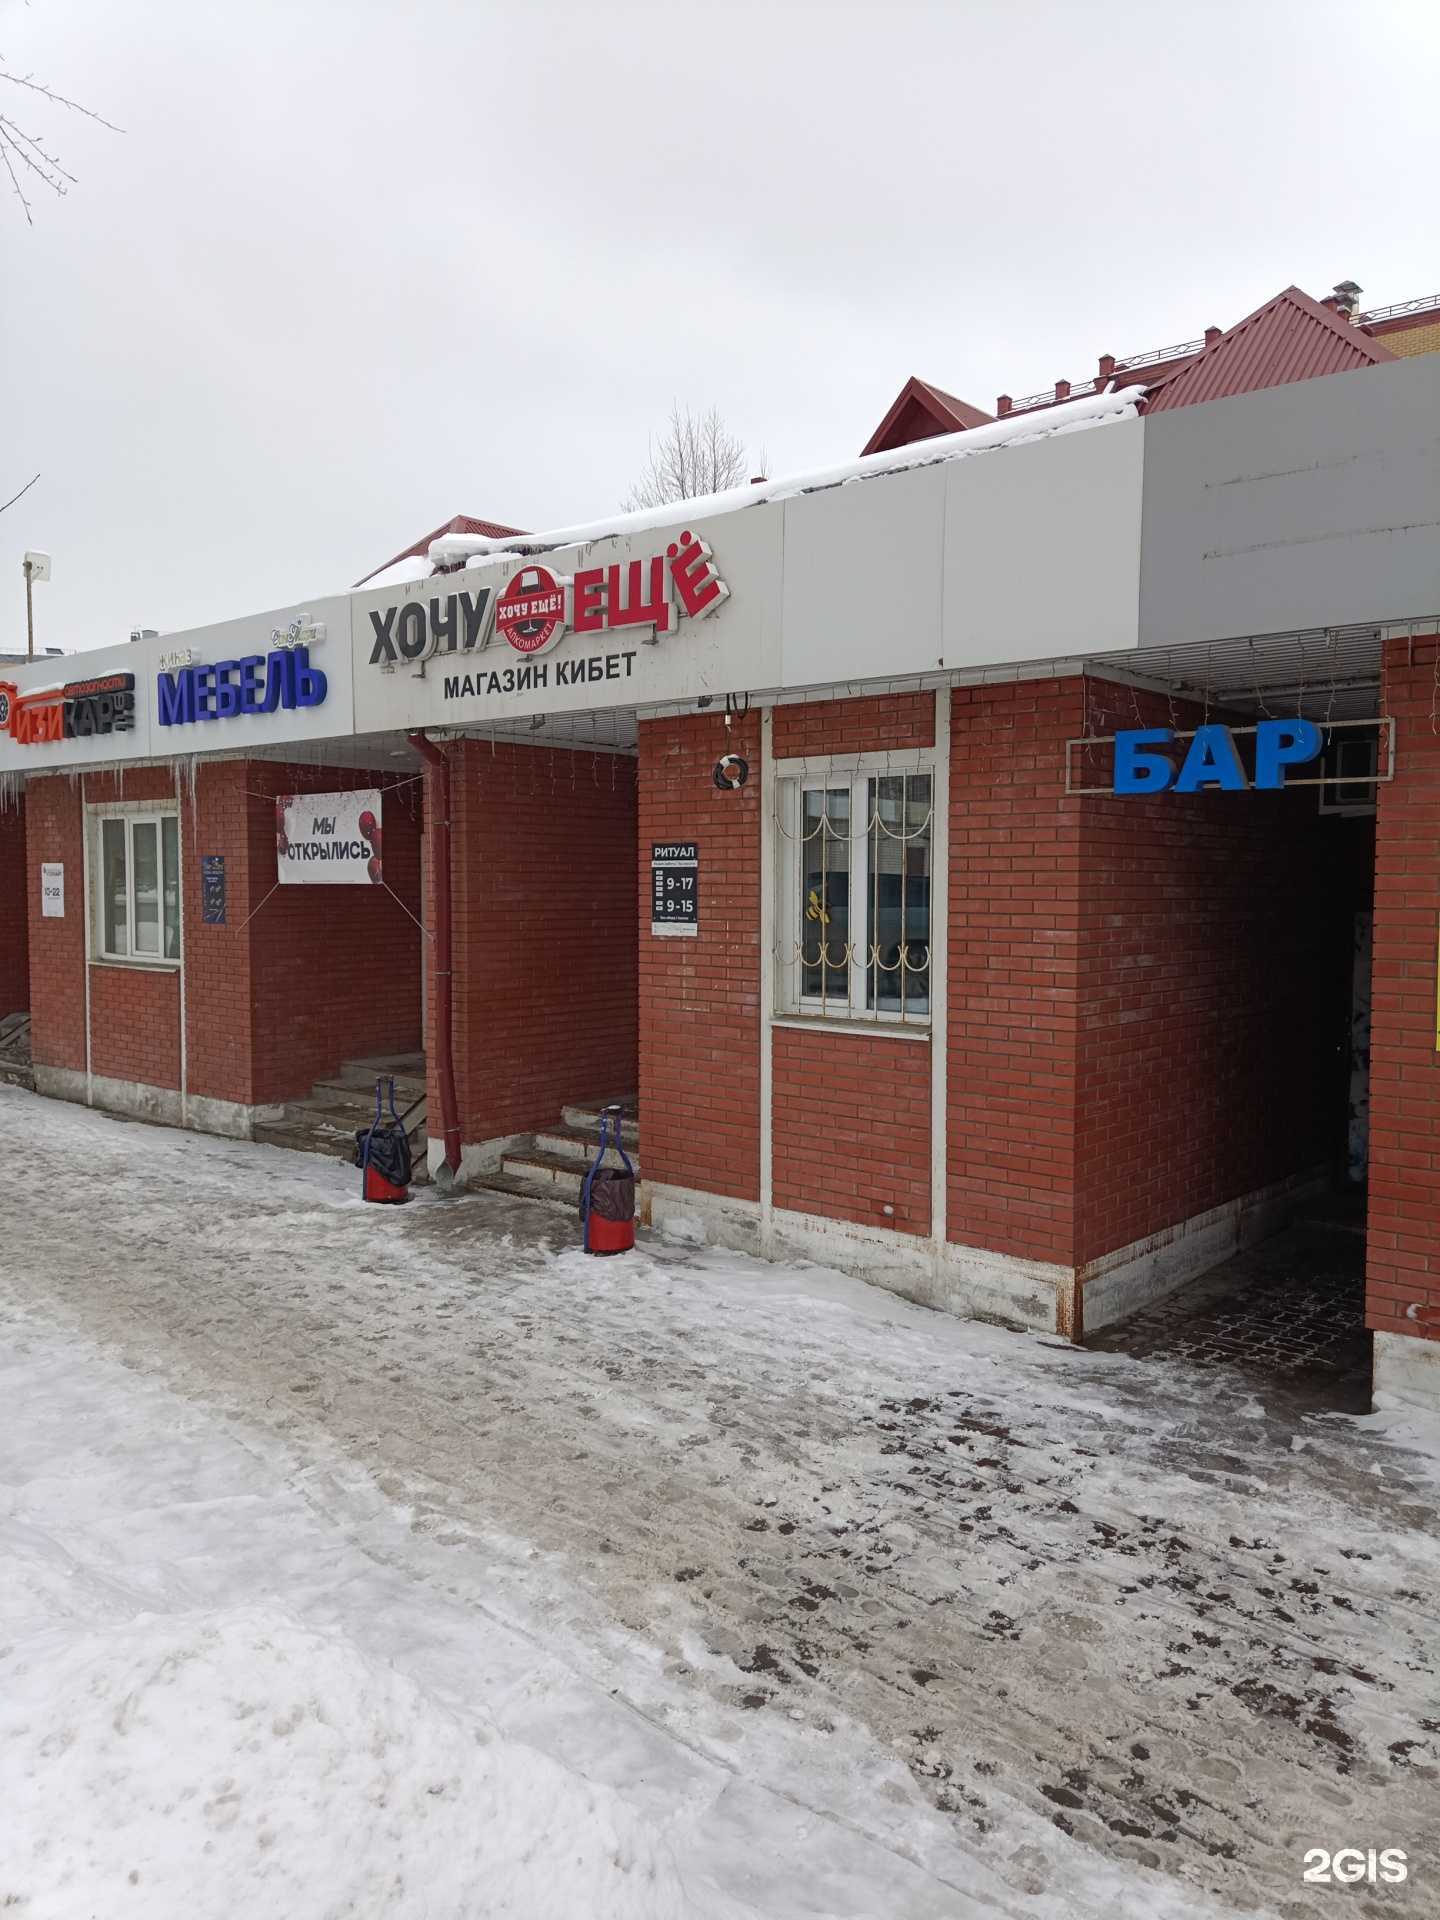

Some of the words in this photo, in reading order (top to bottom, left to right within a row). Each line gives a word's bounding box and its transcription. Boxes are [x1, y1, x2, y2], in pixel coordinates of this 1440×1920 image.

[369, 588, 492, 666] ХОЧУ
[574, 530, 724, 633] ЕЩЁ
[499, 602, 528, 620] ХОЧУ
[530, 594, 562, 615] ЕЩЁ!
[506, 622, 553, 650] АЛКОМАРКЕТ
[158, 647, 328, 726] МЕБЕЛЬ
[443, 659, 548, 699] МАГАЗИН
[555, 651, 637, 685] КИБЕТ
[1113, 719, 1323, 795] БАР
[312, 816, 336, 835] МЫ
[288, 841, 371, 860] ОТКРЫЛИСЬ
[654, 846, 695, 857] РИТУАЛ
[666, 877, 694, 890] 9-17
[666, 899, 694, 912] 9-15
